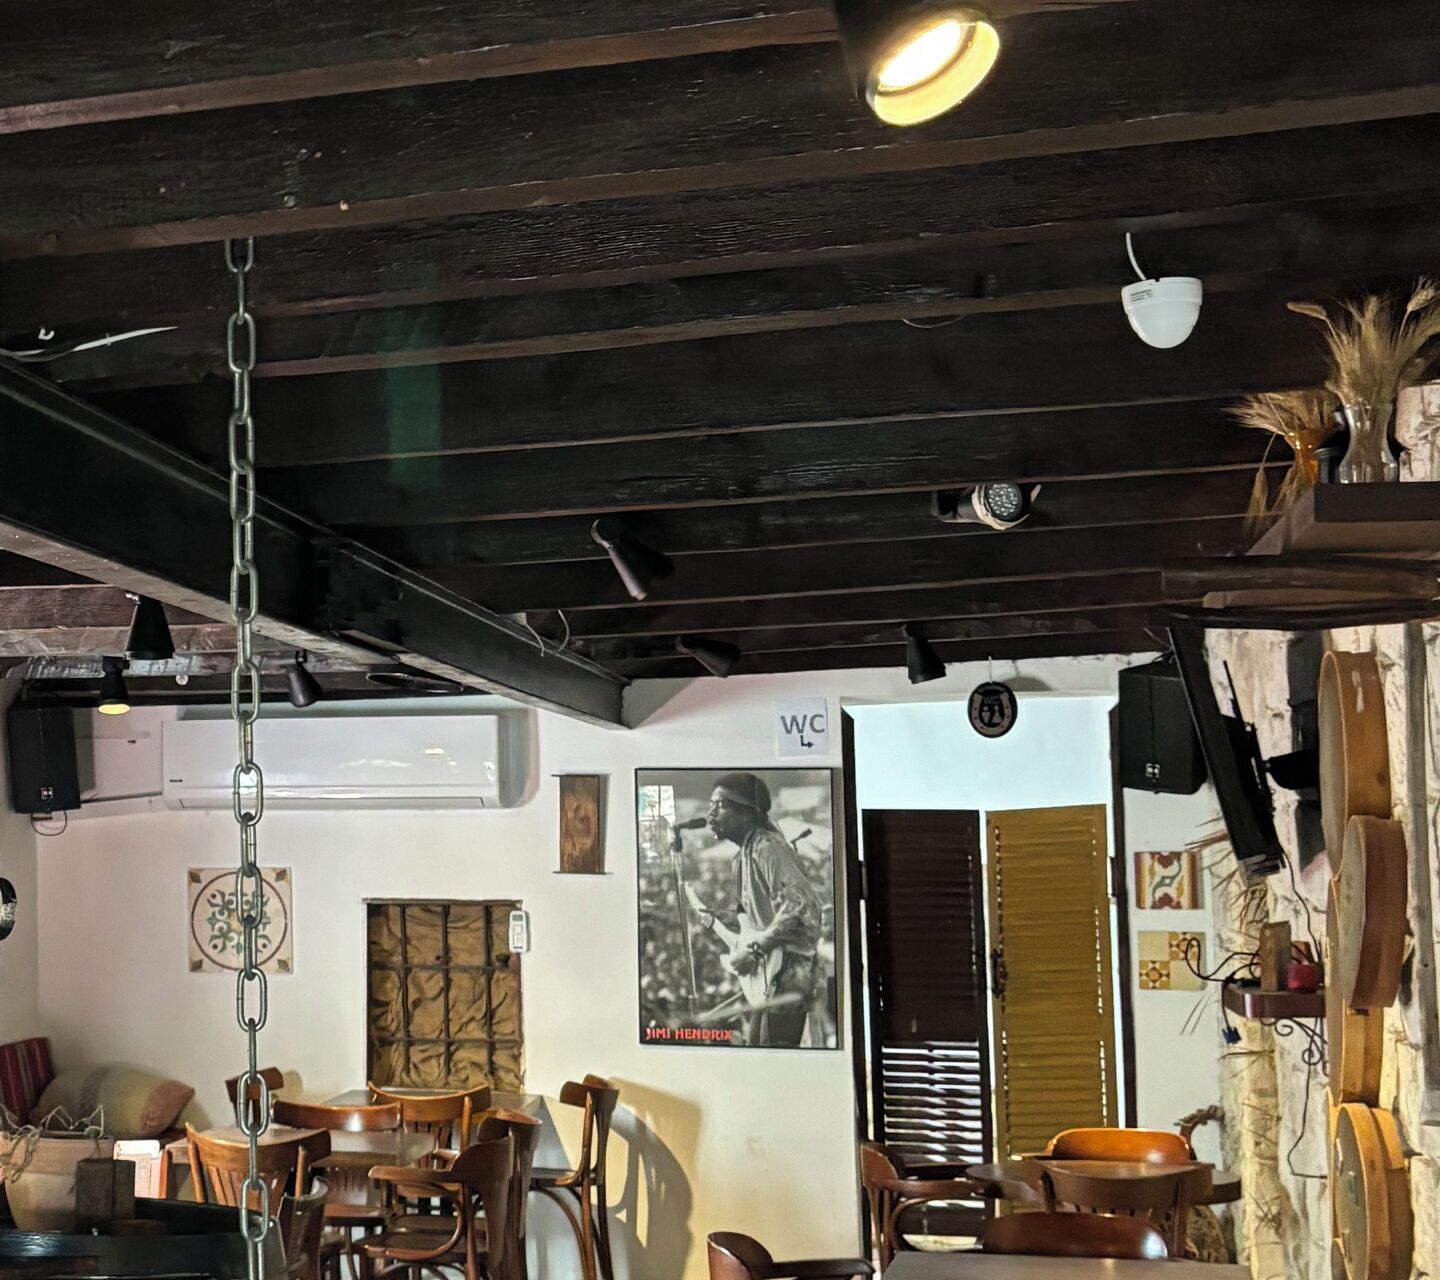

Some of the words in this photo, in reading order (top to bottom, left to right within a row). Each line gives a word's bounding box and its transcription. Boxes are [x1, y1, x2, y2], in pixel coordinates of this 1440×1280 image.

[780, 713, 826, 735] WC
[645, 1027, 671, 1041] JIMI
[674, 1027, 733, 1041] HENDRIX
